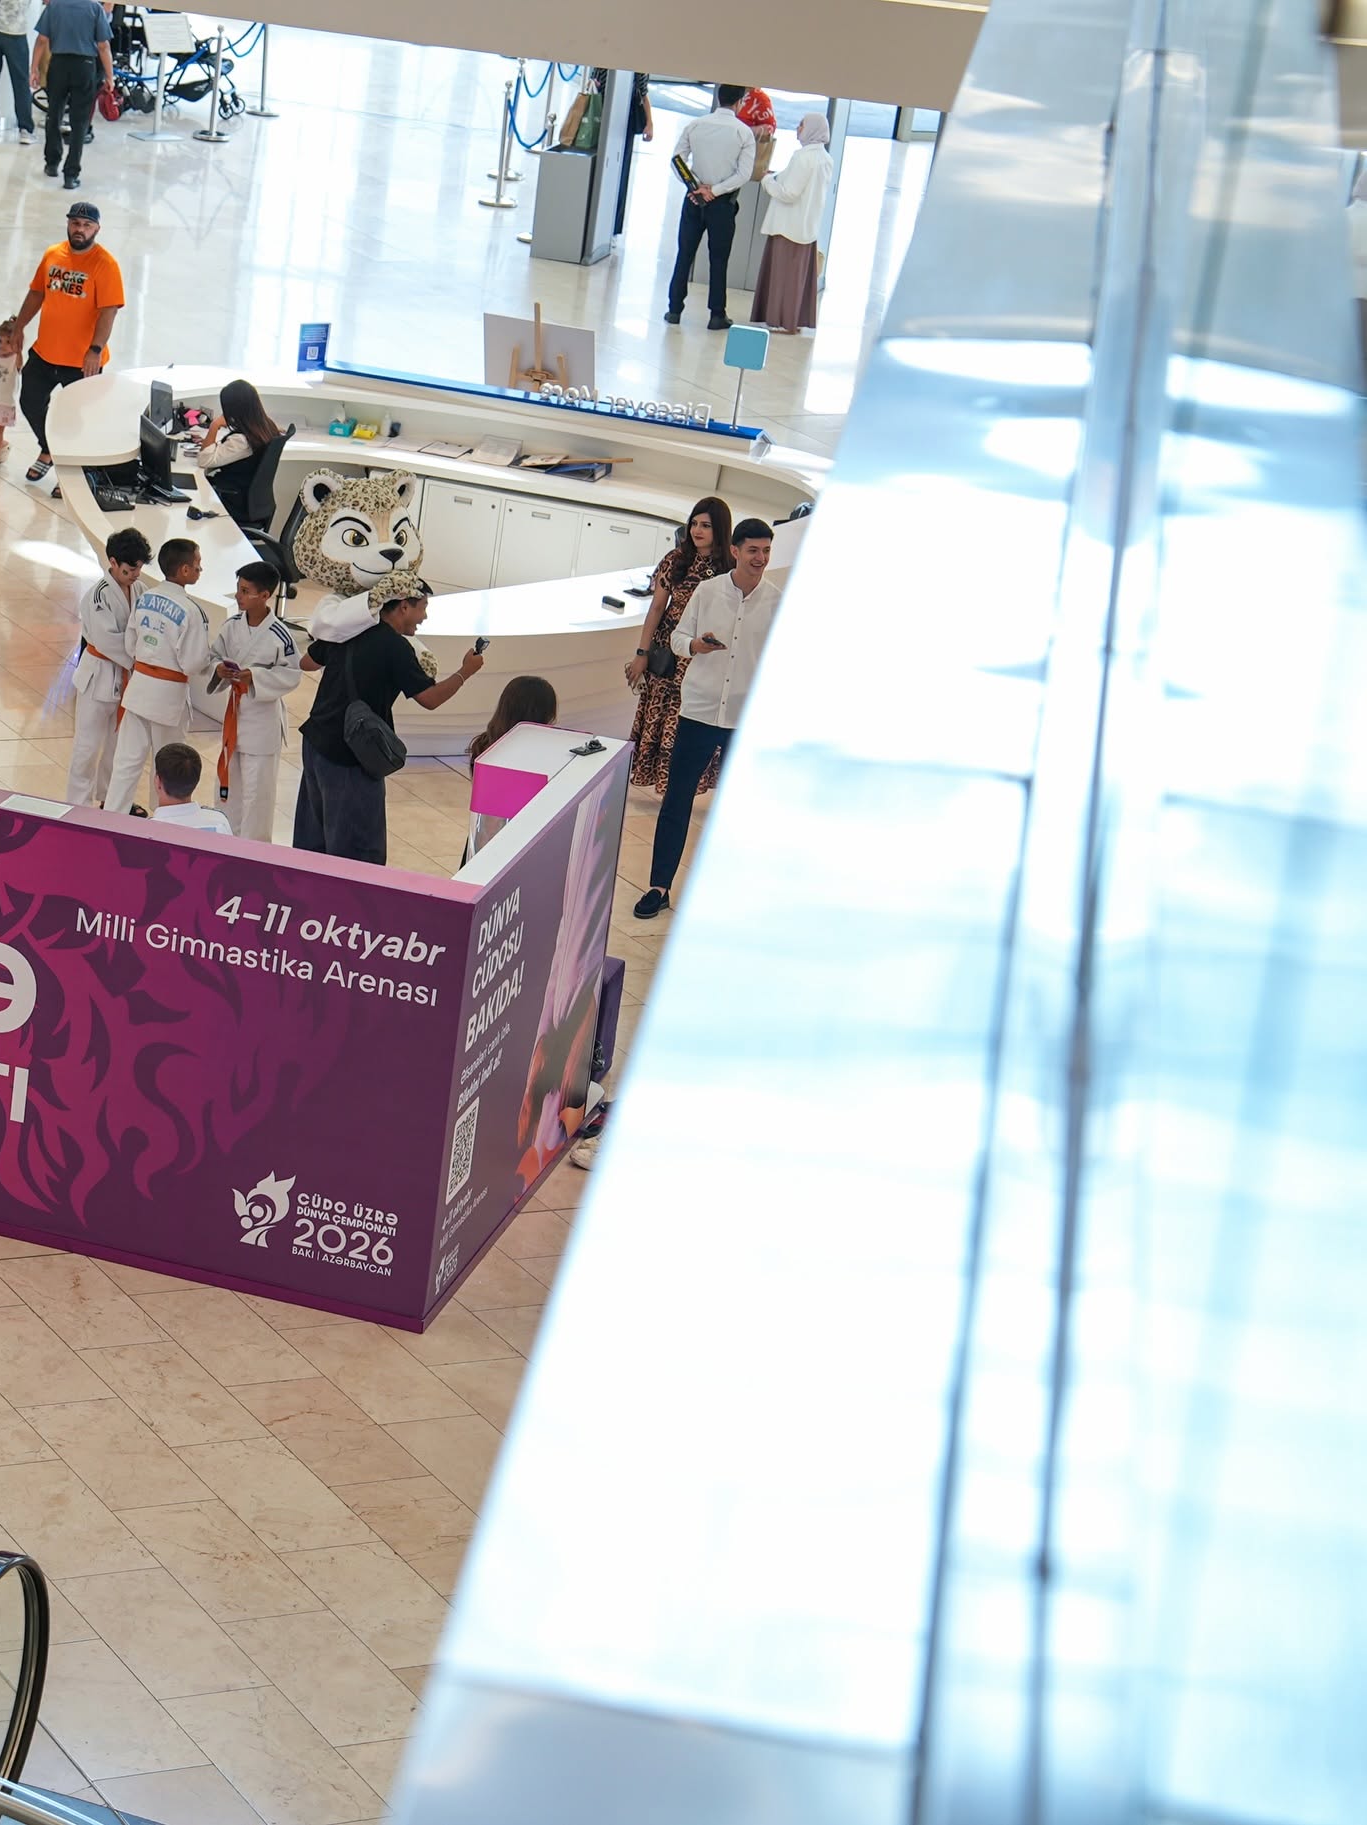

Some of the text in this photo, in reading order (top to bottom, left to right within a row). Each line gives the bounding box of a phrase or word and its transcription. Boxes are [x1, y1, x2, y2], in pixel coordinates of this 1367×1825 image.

[299, 915, 446, 967] oktyabr
[477, 886, 521, 955] DÜNYA
[75, 907, 437, 1007] Milli Gimnastika Arenası
[472, 921, 524, 999] CÜDOSU
[465, 960, 525, 1053] BAKIDA!
[296, 1206, 330, 1221] DÜNYA
[297, 1193, 399, 1226] CÜDO ÜZRƏ
[292, 1247, 392, 1276] BAKI AZƏRBAYCAN
[293, 1218, 394, 1265] 2026
